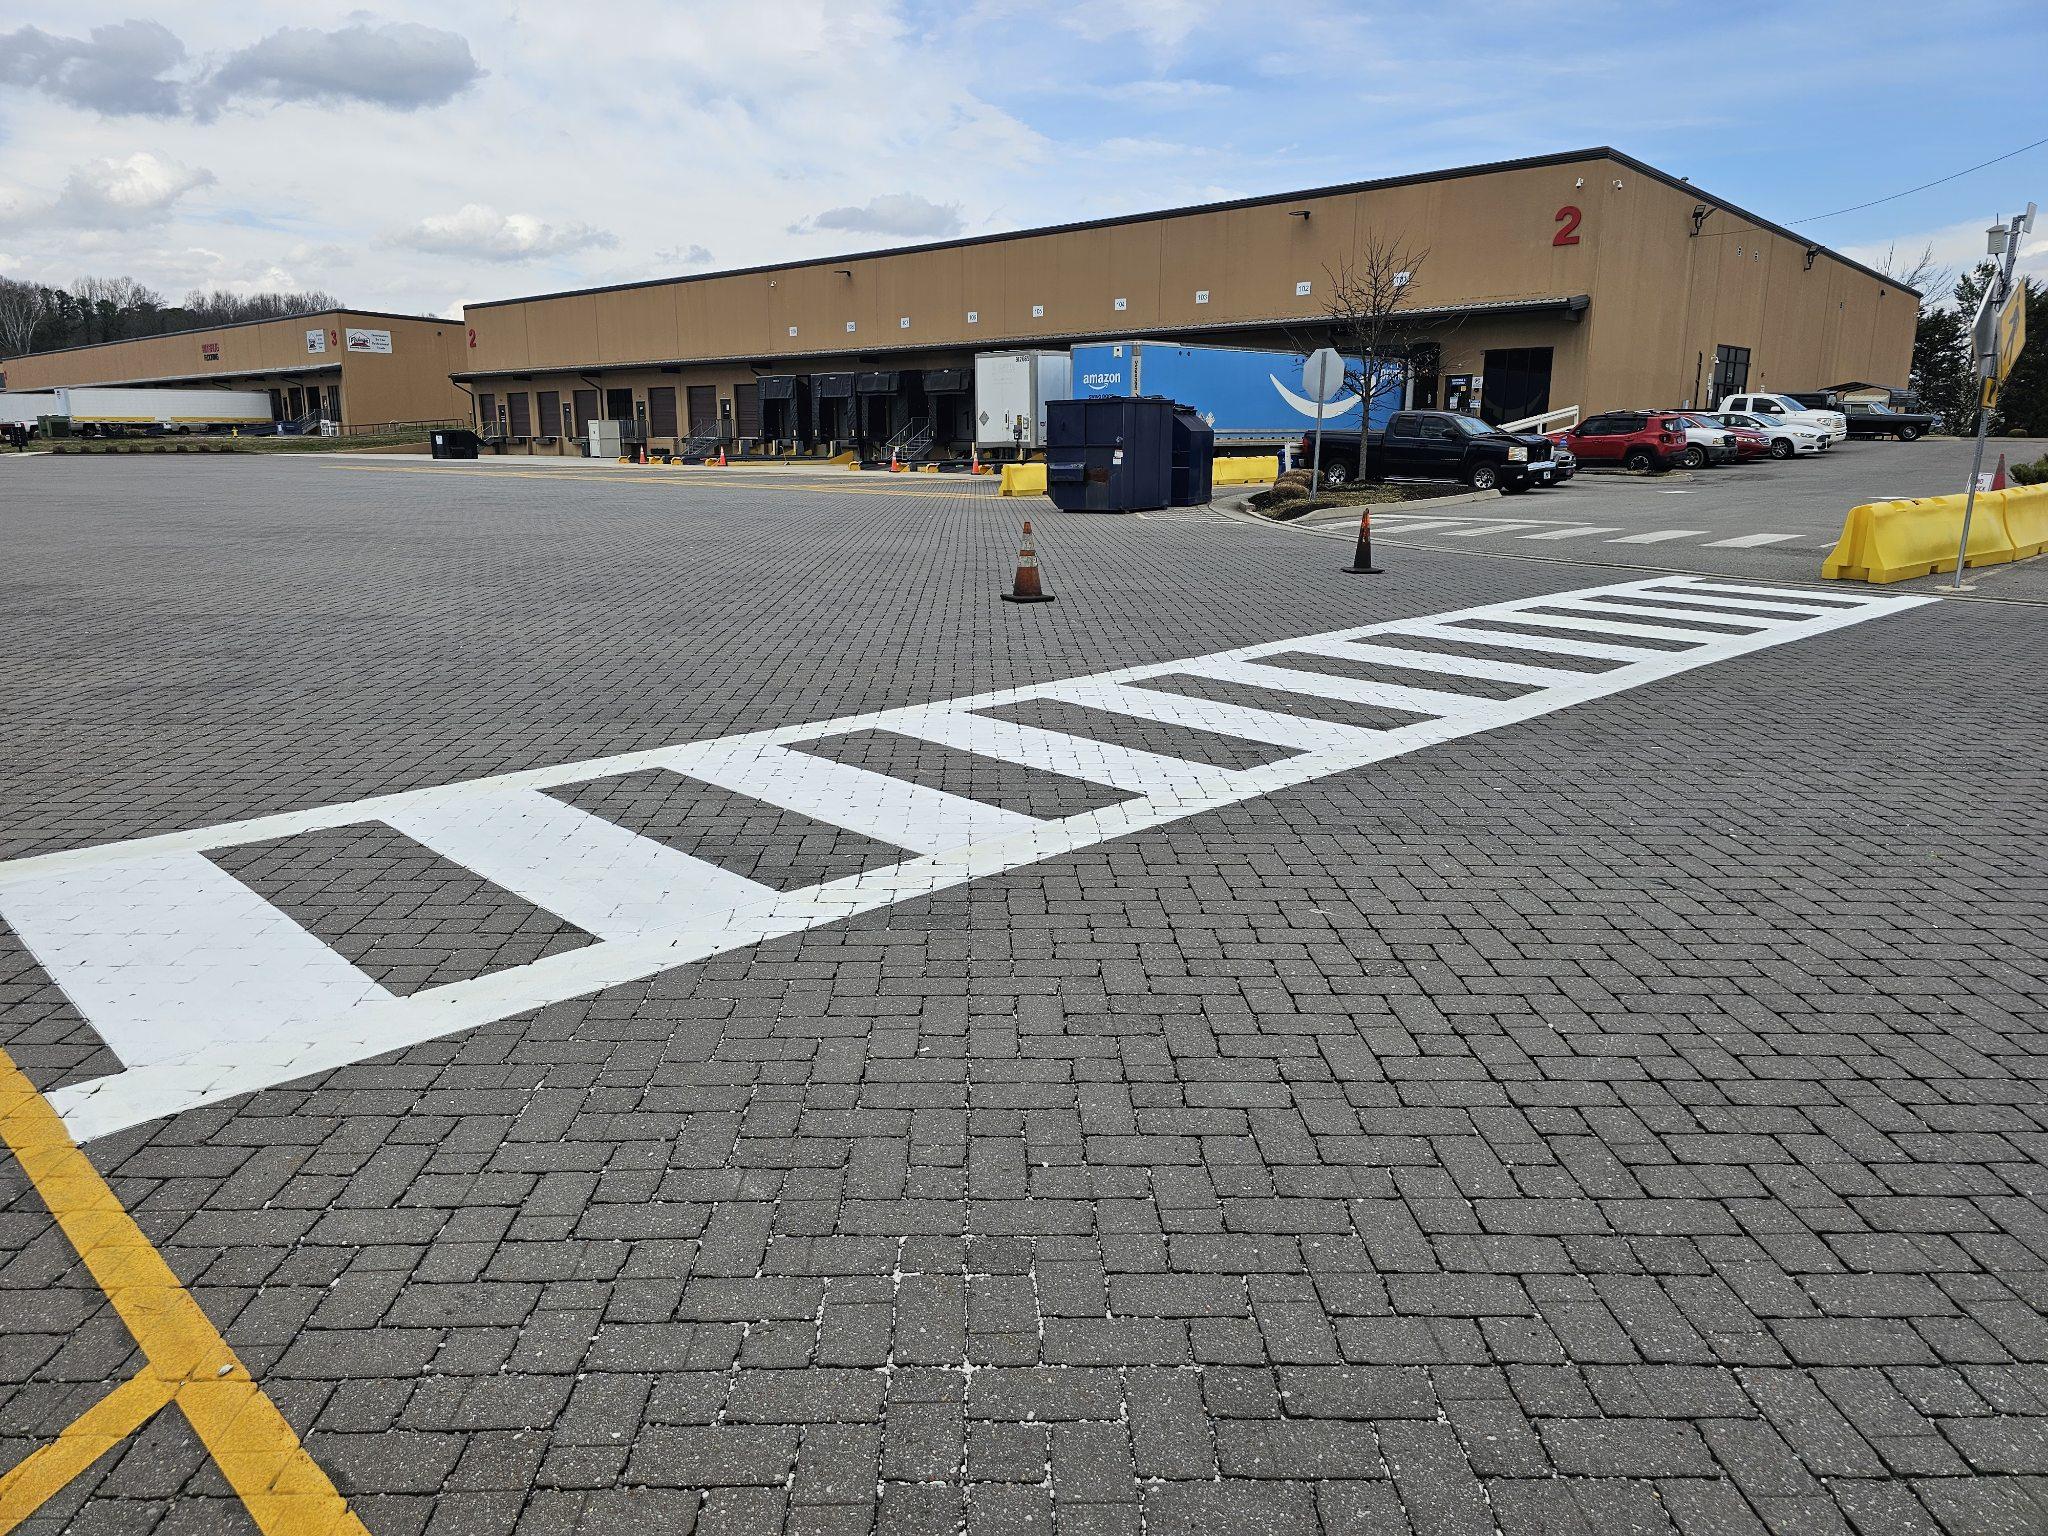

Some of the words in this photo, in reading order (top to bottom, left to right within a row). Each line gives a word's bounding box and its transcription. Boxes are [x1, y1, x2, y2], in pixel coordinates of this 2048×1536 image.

[1552, 205, 1582, 246] 2
[1298, 285, 1309, 293] 102
[1197, 293, 1208, 301] 103
[1116, 300, 1125, 308] 104
[330, 329, 338, 346] 3
[468, 328, 477, 348] 2
[1083, 372, 1121, 384] amazon
